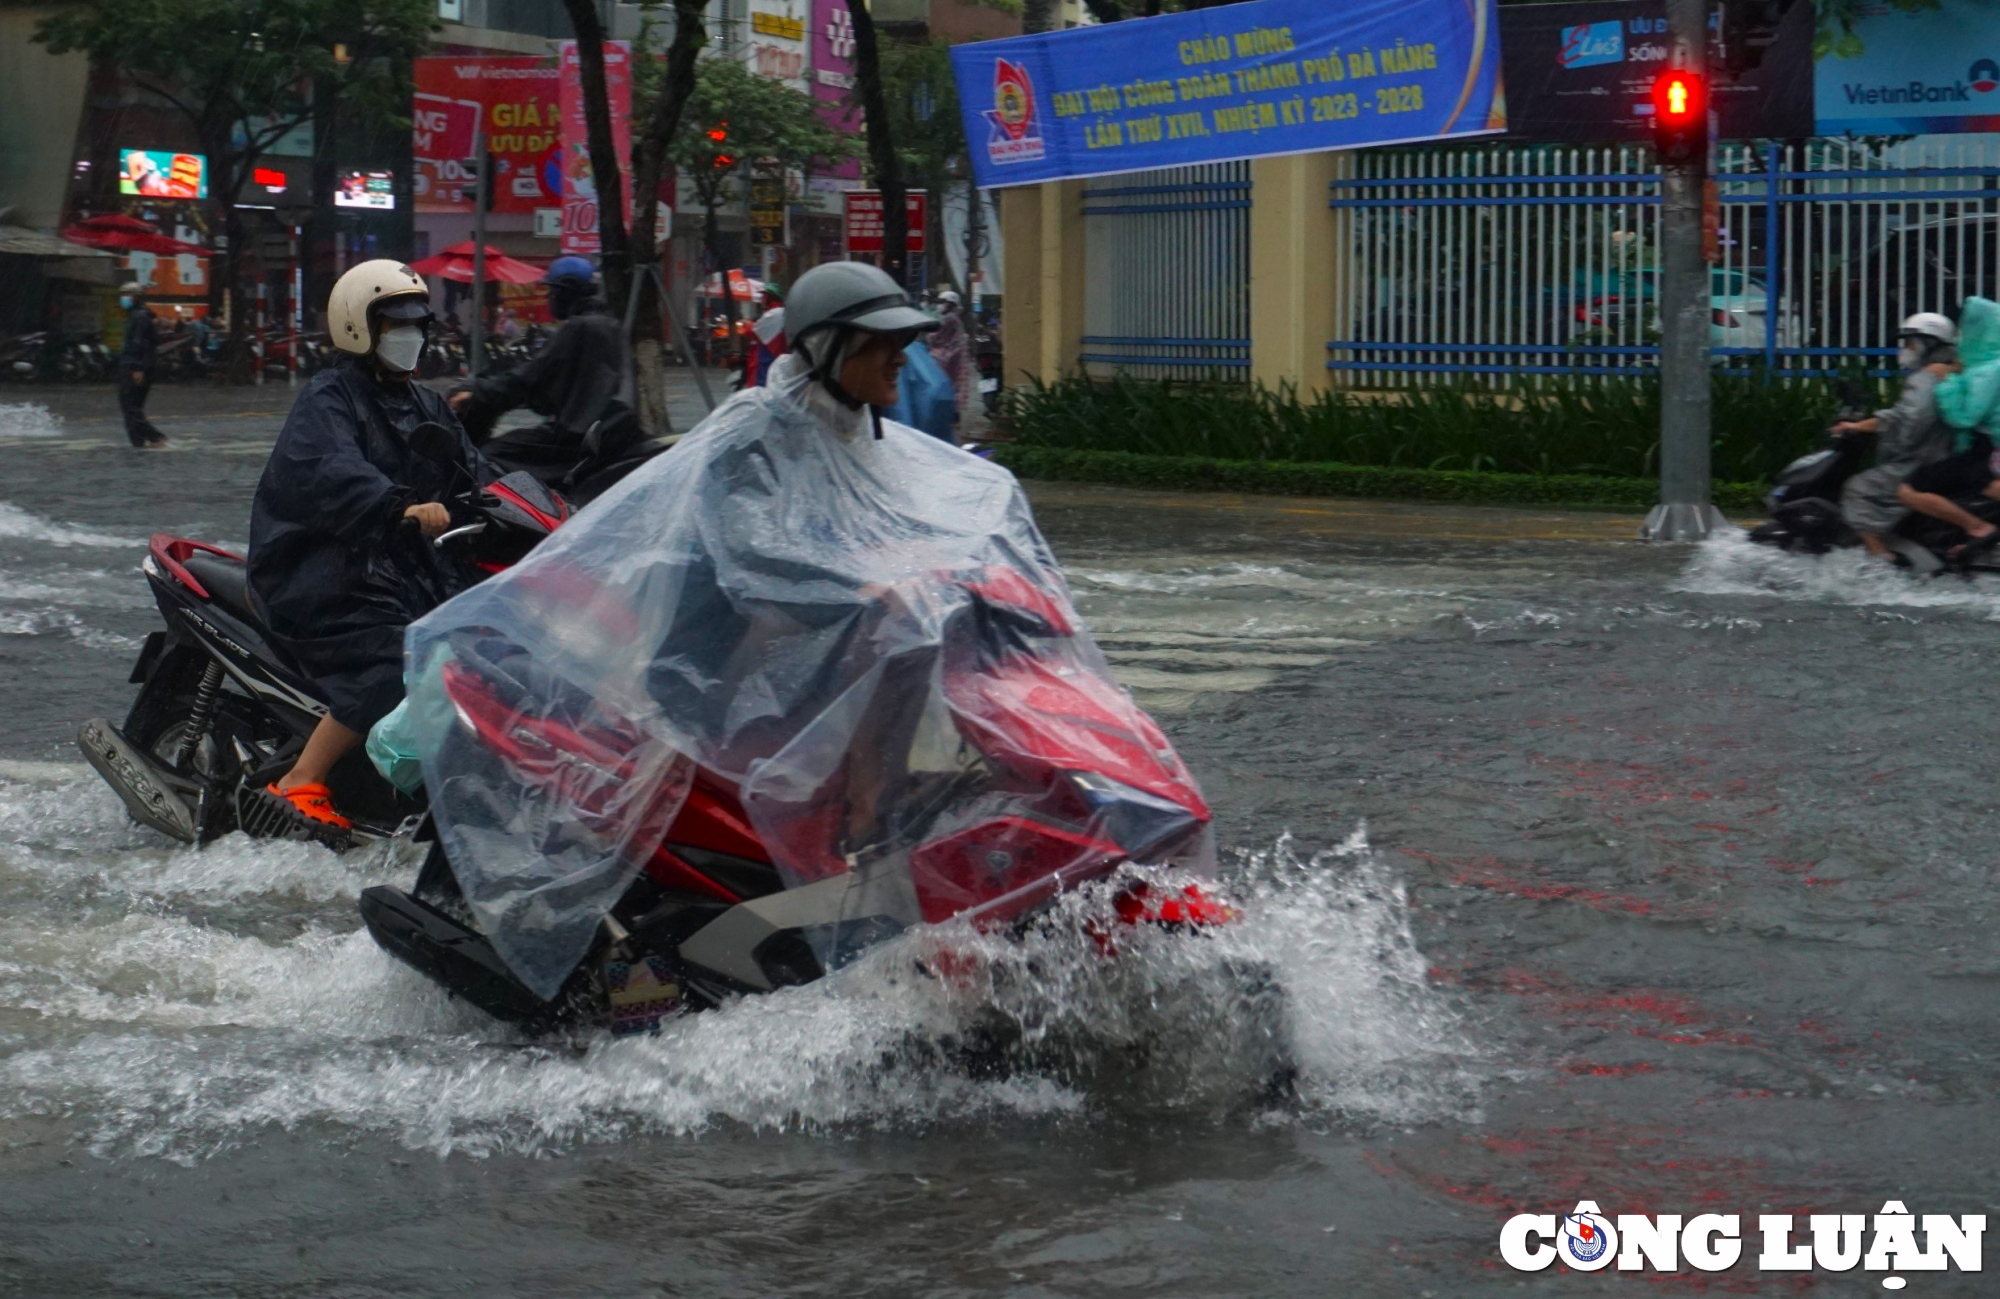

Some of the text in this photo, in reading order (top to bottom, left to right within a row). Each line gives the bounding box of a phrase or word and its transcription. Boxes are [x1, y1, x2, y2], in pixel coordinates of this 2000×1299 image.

[1178, 26, 1295, 65] CHÀO MỪNG
[1053, 37, 1437, 120] ĐẠI HỘI CÔNG ĐOÀN THÀNH PHỐ ĐÀ NẴNG
[1843, 80, 1970, 105] VietinBank
[492, 96, 543, 127] GIÁ
[1085, 115, 1123, 149] LẦN
[1126, 112, 1163, 144] THỨ
[1213, 99, 1277, 135] NHIỆM
[1281, 94, 1305, 126] KỲ
[1312, 92, 1359, 122] 2023
[1376, 84, 1424, 115] 2028
